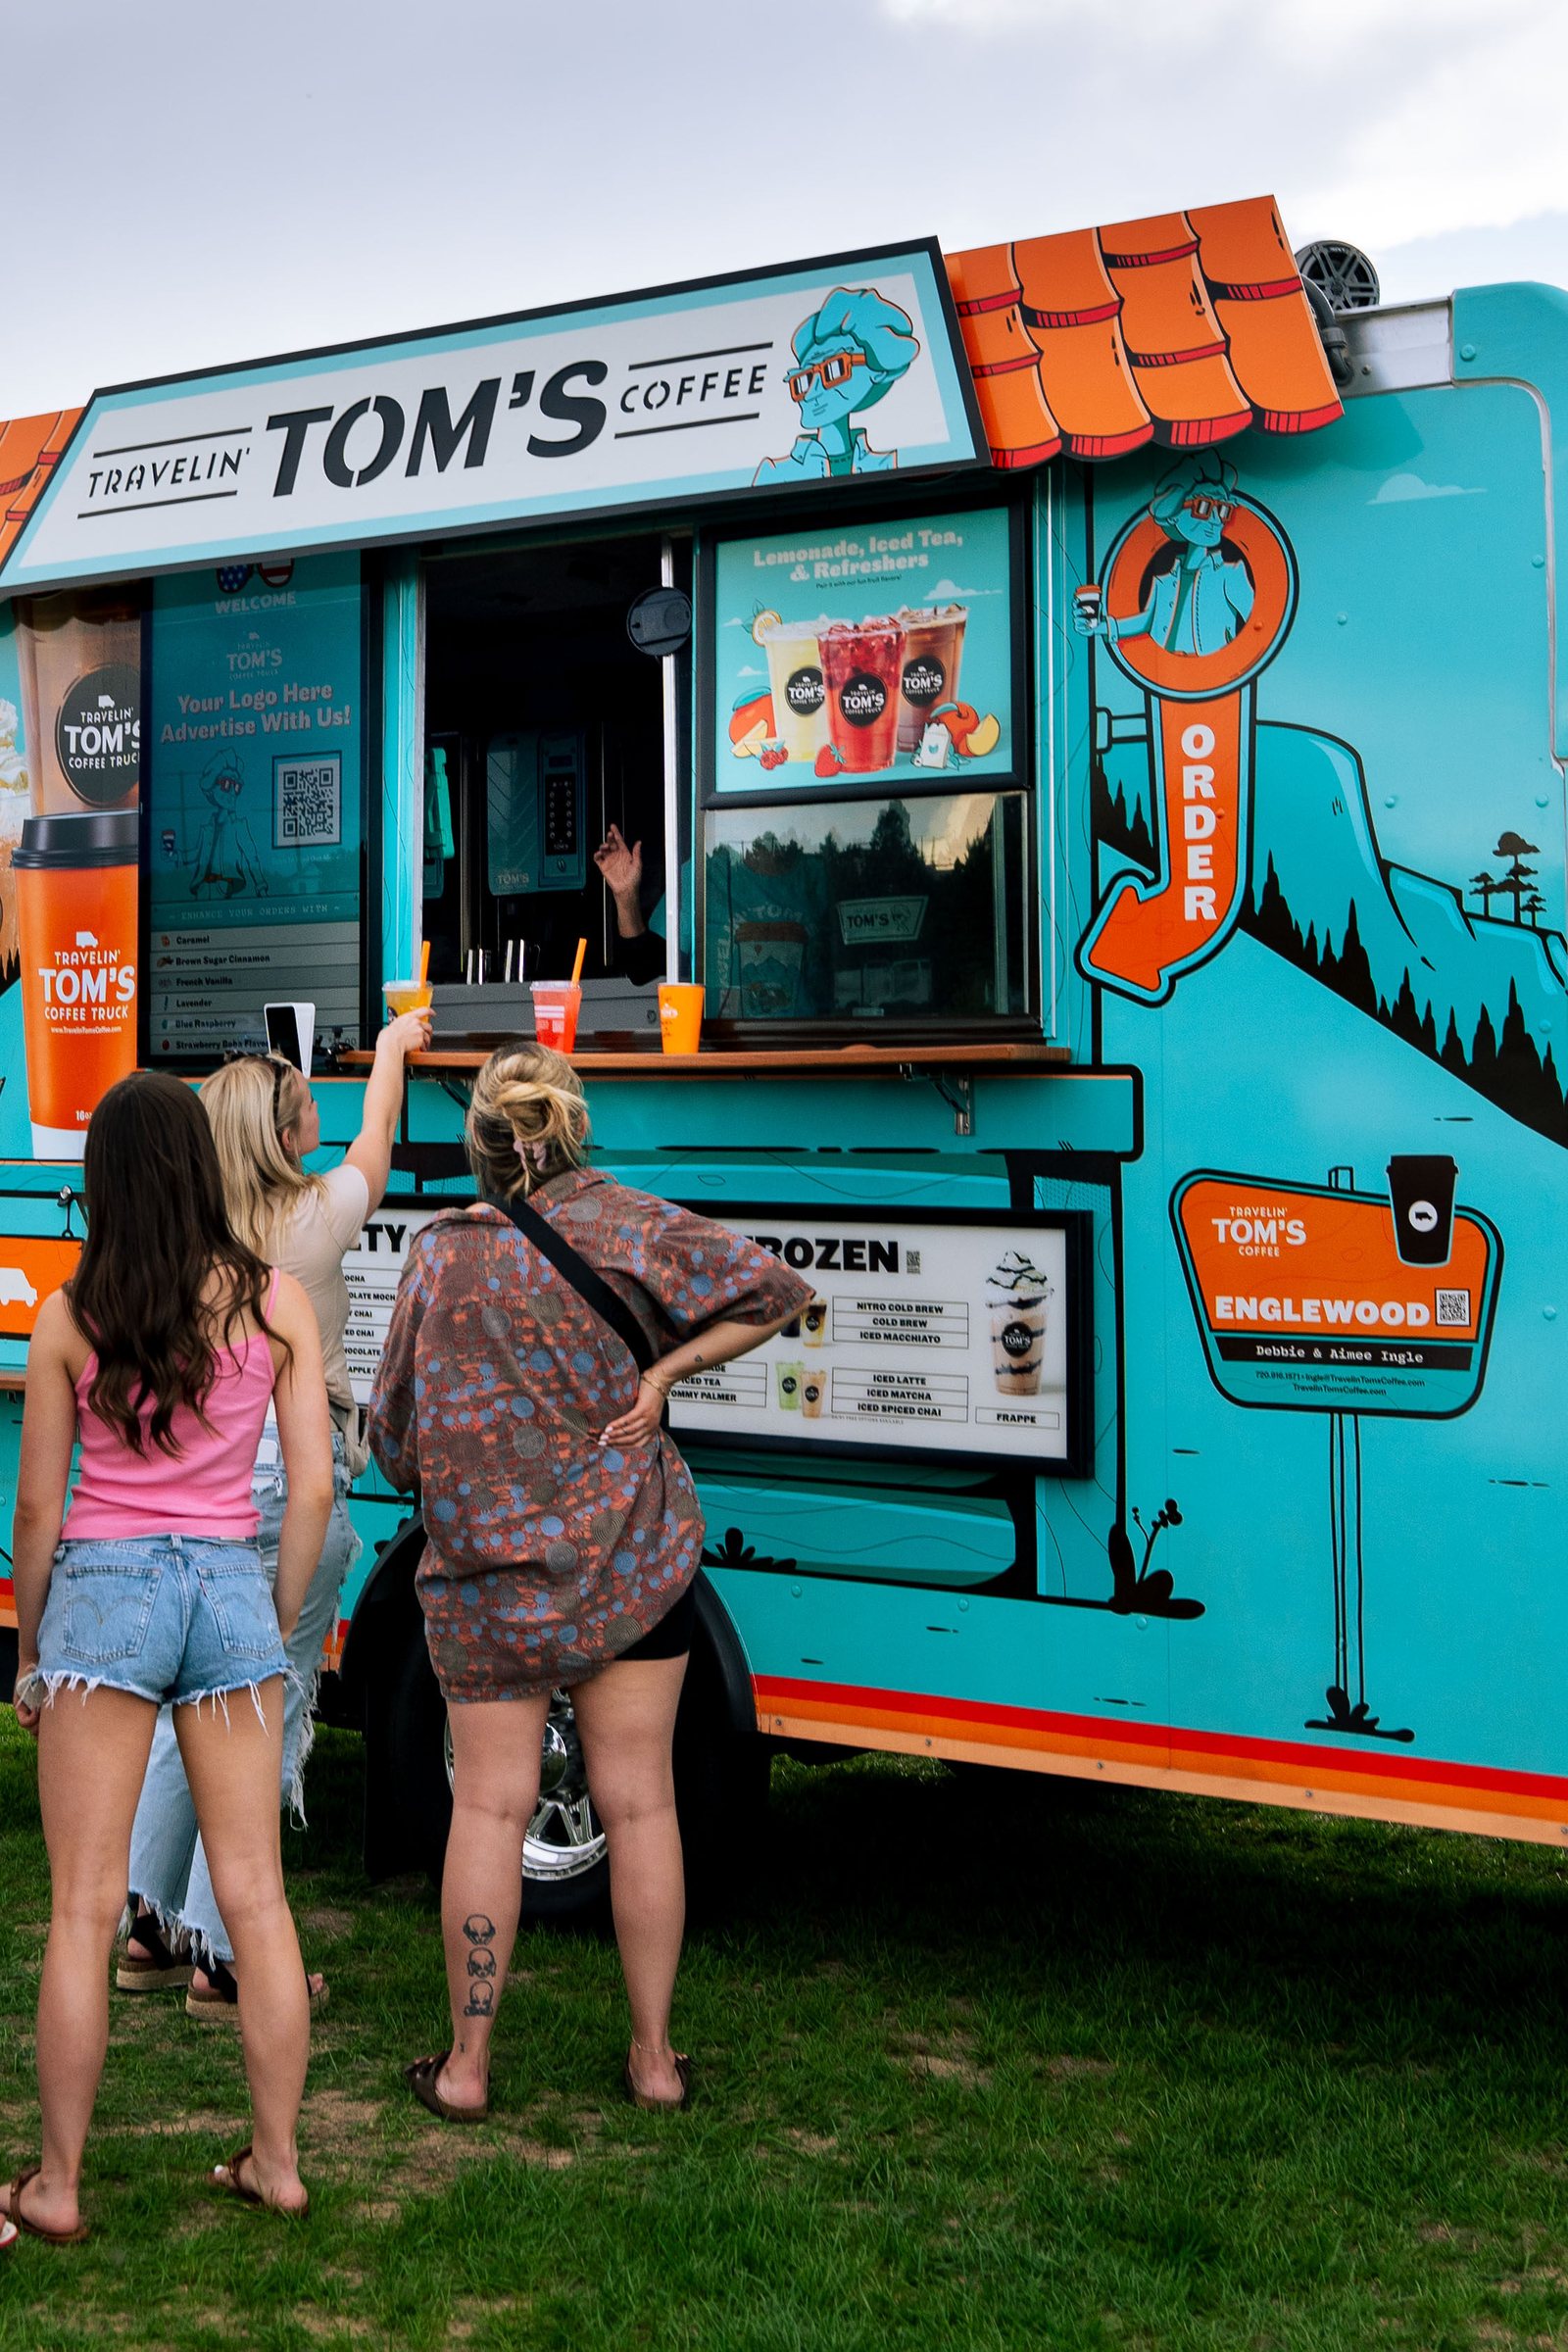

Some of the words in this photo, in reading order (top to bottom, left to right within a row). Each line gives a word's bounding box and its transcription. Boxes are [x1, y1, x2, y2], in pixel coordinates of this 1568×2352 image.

[89, 448, 250, 498] TRAVELIN'
[266, 360, 609, 497] TOM'S
[619, 365, 767, 414] COFFEE
[754, 540, 864, 567] Lemonade,
[869, 532, 913, 554] Iced
[918, 529, 963, 548] Tea,
[790, 564, 809, 581] &
[814, 554, 929, 579] Refreshers
[216, 592, 296, 613] WELCOME
[226, 648, 282, 671] TOM'S
[903, 673, 943, 690] TOM'S
[177, 695, 224, 714] Your
[229, 689, 278, 711] Logo
[283, 683, 333, 704] Here
[788, 684, 825, 700] TOM'S
[842, 693, 885, 710] TOM'S
[80, 706, 134, 724] TRAVELIN'
[161, 717, 256, 744] Advertise
[261, 710, 312, 733] With
[317, 705, 352, 727] Us!
[69, 757, 106, 769] COFFEE
[1181, 723, 1217, 921] ORDER
[846, 913, 890, 929] TOM'S
[176, 935, 211, 945] Caramel
[54, 949, 121, 965] TRAVELIN'
[175, 957, 202, 966] Brown
[203, 956, 228, 965] Sugar
[228, 955, 270, 963] Cinnamon
[38, 965, 136, 1004] TOM'S
[176, 977, 204, 987] French
[205, 976, 233, 986] Vanilla
[176, 999, 213, 1008] Lavender
[44, 1006, 86, 1021] COFFEE
[91, 1004, 129, 1020] TRUCK
[175, 1019, 194, 1029] Blue
[194, 1019, 236, 1029] Raspberry
[175, 1041, 221, 1050] Strawberry
[221, 1040, 243, 1049] Boba
[1229, 1205, 1288, 1218] TRAVELIN'
[1211, 1218, 1307, 1246] TOM'S
[745, 1235, 900, 1274] ROZEN
[1238, 1246, 1280, 1257] COFFEE
[344, 1274, 366, 1283] OCHA
[348, 1292, 372, 1300] OLATE
[372, 1293, 396, 1301] MOCH
[856, 1301, 886, 1312] NITRO
[888, 1302, 913, 1313] COLD
[914, 1304, 944, 1315] BREW
[1214, 1295, 1431, 1327] ENGLEWOOD
[872, 1317, 898, 1327] COLD
[899, 1318, 928, 1329] BREW
[859, 1331, 882, 1341] ICED
[883, 1333, 941, 1345] MACCHIATO
[344, 1347, 381, 1356] HOCOLATE
[1255, 1345, 1305, 1358] Debbie
[1313, 1348, 1323, 1359] &
[1329, 1347, 1373, 1362] Aimee
[1381, 1350, 1424, 1365] Ingle
[348, 1365, 371, 1375] APPLE
[704, 1378, 721, 1387] TEA
[872, 1374, 895, 1384] ICED
[896, 1375, 927, 1386] LATTE
[669, 1390, 699, 1399] OMMY
[701, 1392, 737, 1402] PALMER
[866, 1389, 890, 1398] ICED
[890, 1390, 932, 1401] MATCHA
[857, 1402, 879, 1412] ICED
[880, 1403, 916, 1415] SPICED
[916, 1406, 942, 1417] CHAI
[996, 1413, 1037, 1425] FRAPPE
